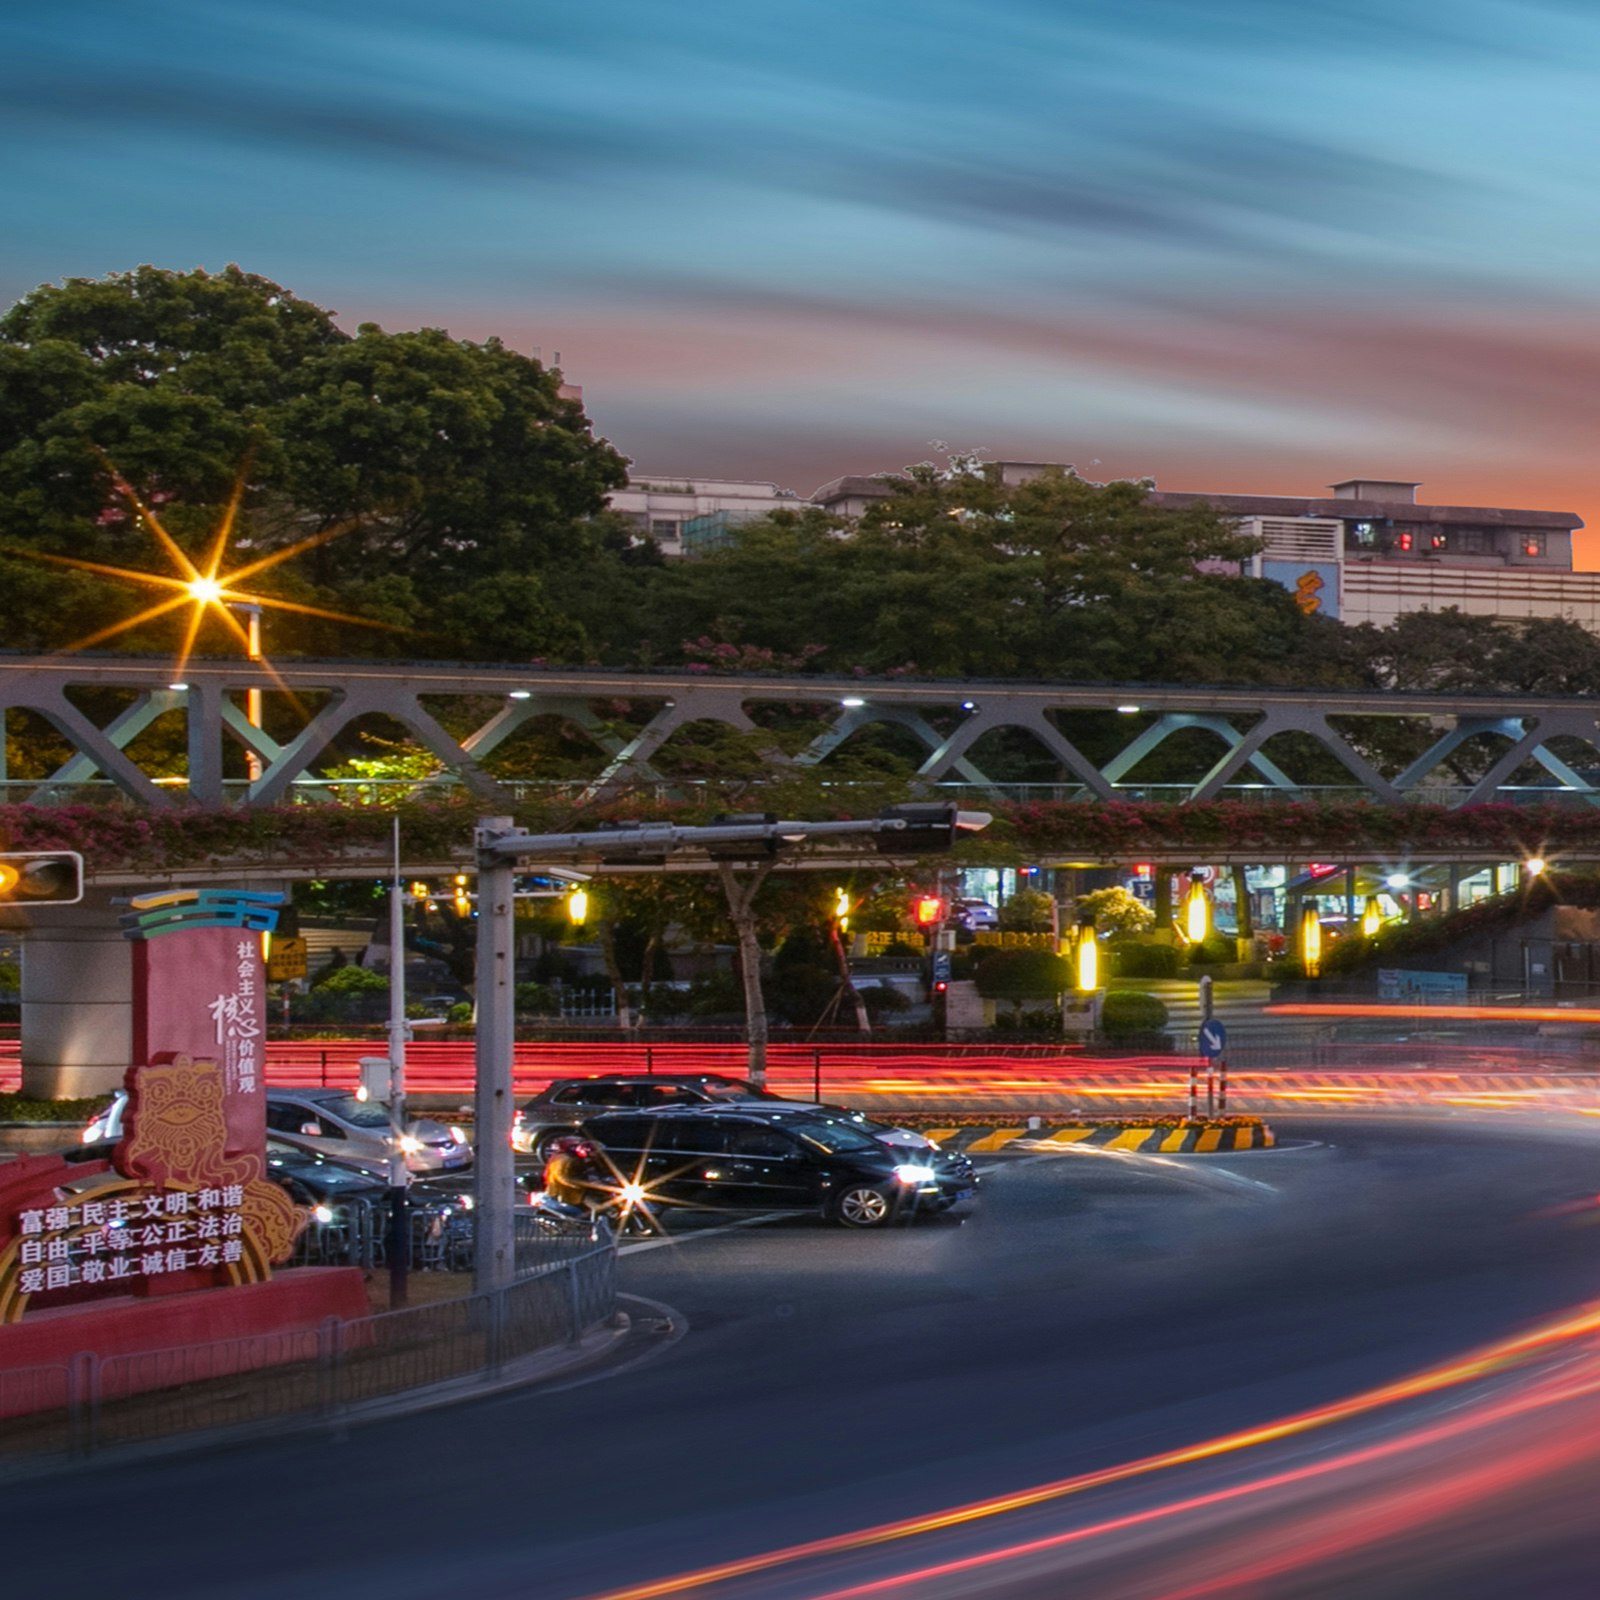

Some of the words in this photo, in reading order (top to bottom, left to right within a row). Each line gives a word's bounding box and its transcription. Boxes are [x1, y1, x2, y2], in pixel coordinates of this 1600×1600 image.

[1138, 883, 1153, 898] P
[208, 941, 261, 1094] 社会主义核心价值观
[19, 1206, 71, 1236] 富强
[82, 1200, 129, 1226] 民主
[141, 1192, 188, 1219] 文明
[198, 1184, 244, 1210] 和谐
[21, 1237, 69, 1264] 自由
[82, 1228, 131, 1255] 平等
[141, 1220, 187, 1246] 公正
[198, 1213, 243, 1238] 法治
[19, 1264, 70, 1293] 爱国
[82, 1256, 131, 1284] 敬业
[141, 1247, 187, 1273] 诚信
[198, 1239, 243, 1266] 友善
